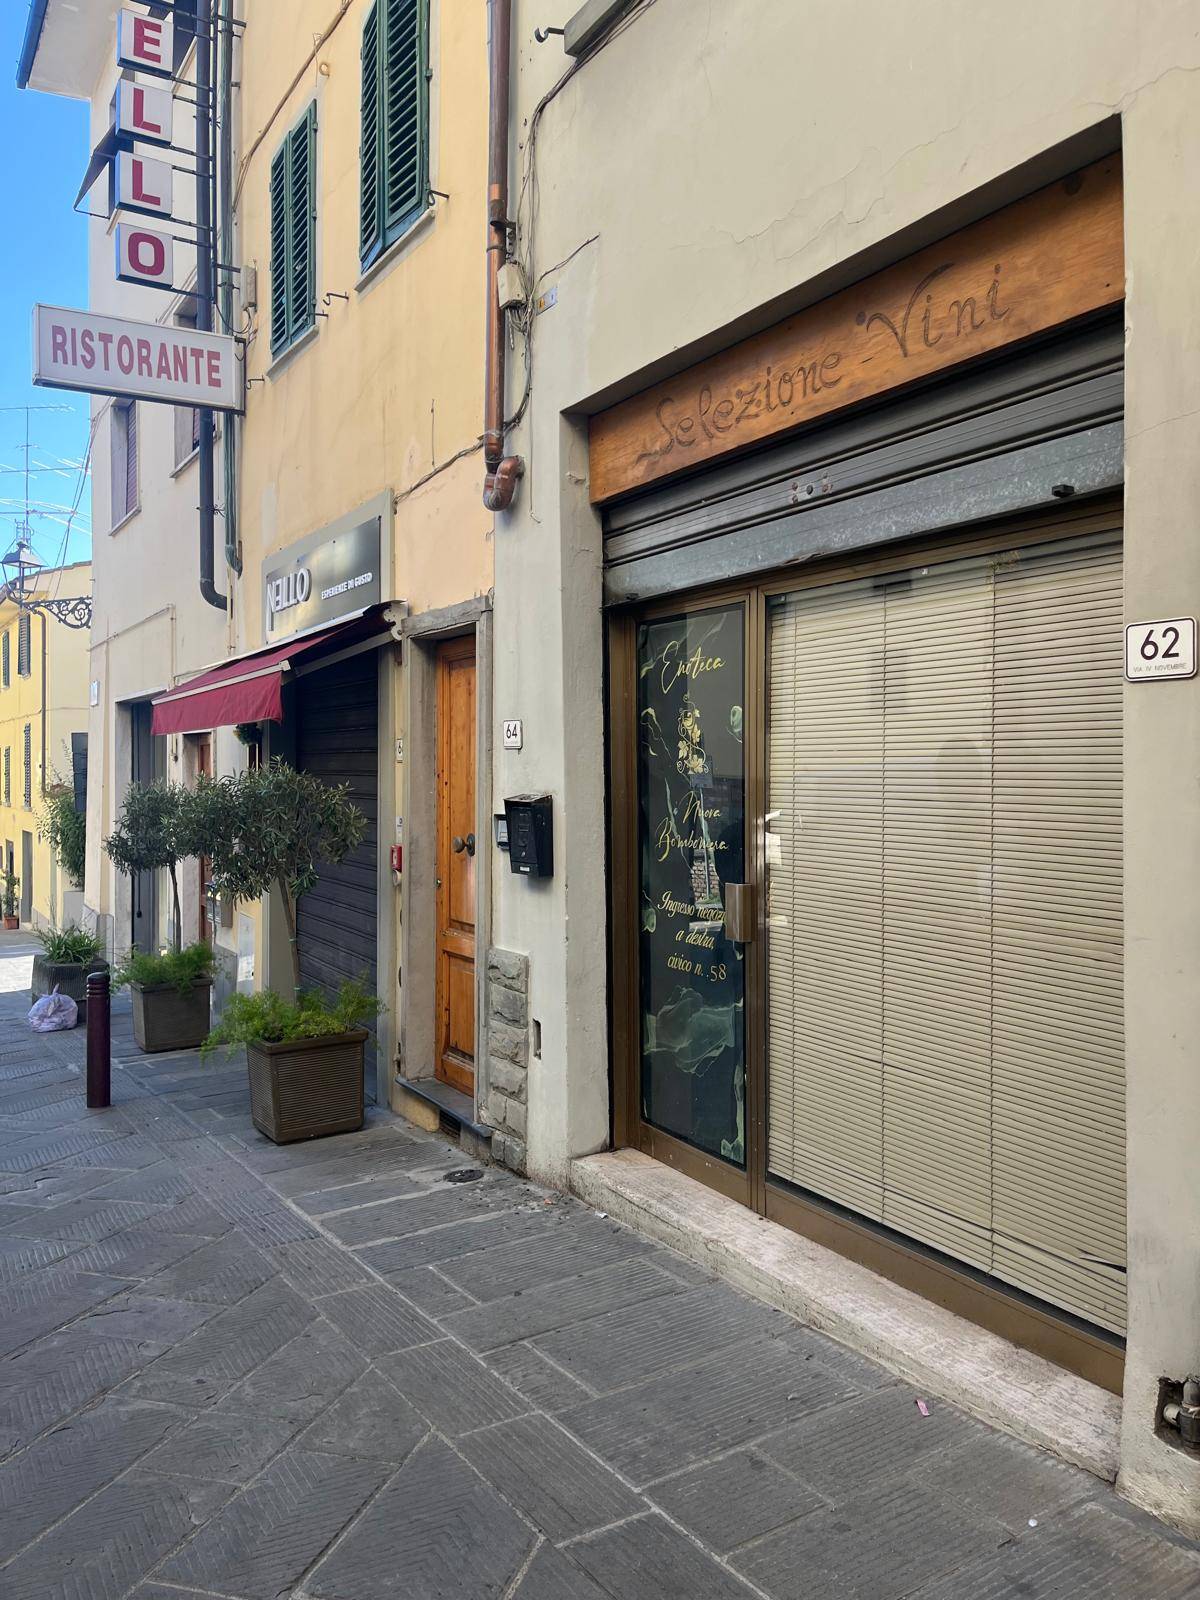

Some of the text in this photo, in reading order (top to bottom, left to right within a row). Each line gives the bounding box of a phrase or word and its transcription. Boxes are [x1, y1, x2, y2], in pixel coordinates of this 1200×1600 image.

[52, 325, 222, 389] RISTORANTE
[635, 262, 1011, 464] Selezione Vini
[266, 568, 311, 631] NELLO
[321, 572, 373, 600] ESPERIENZE DI GUSTO
[1140, 626, 1180, 661] 62
[661, 640, 726, 694] Enoteca
[1133, 665, 1143, 673] VIA
[1154, 662, 1187, 672] NOVEMBRE
[506, 723, 518, 739] 64
[657, 890, 727, 925] Ingresso negozi
[675, 929, 685, 941] a
[667, 952, 692, 972] civico
